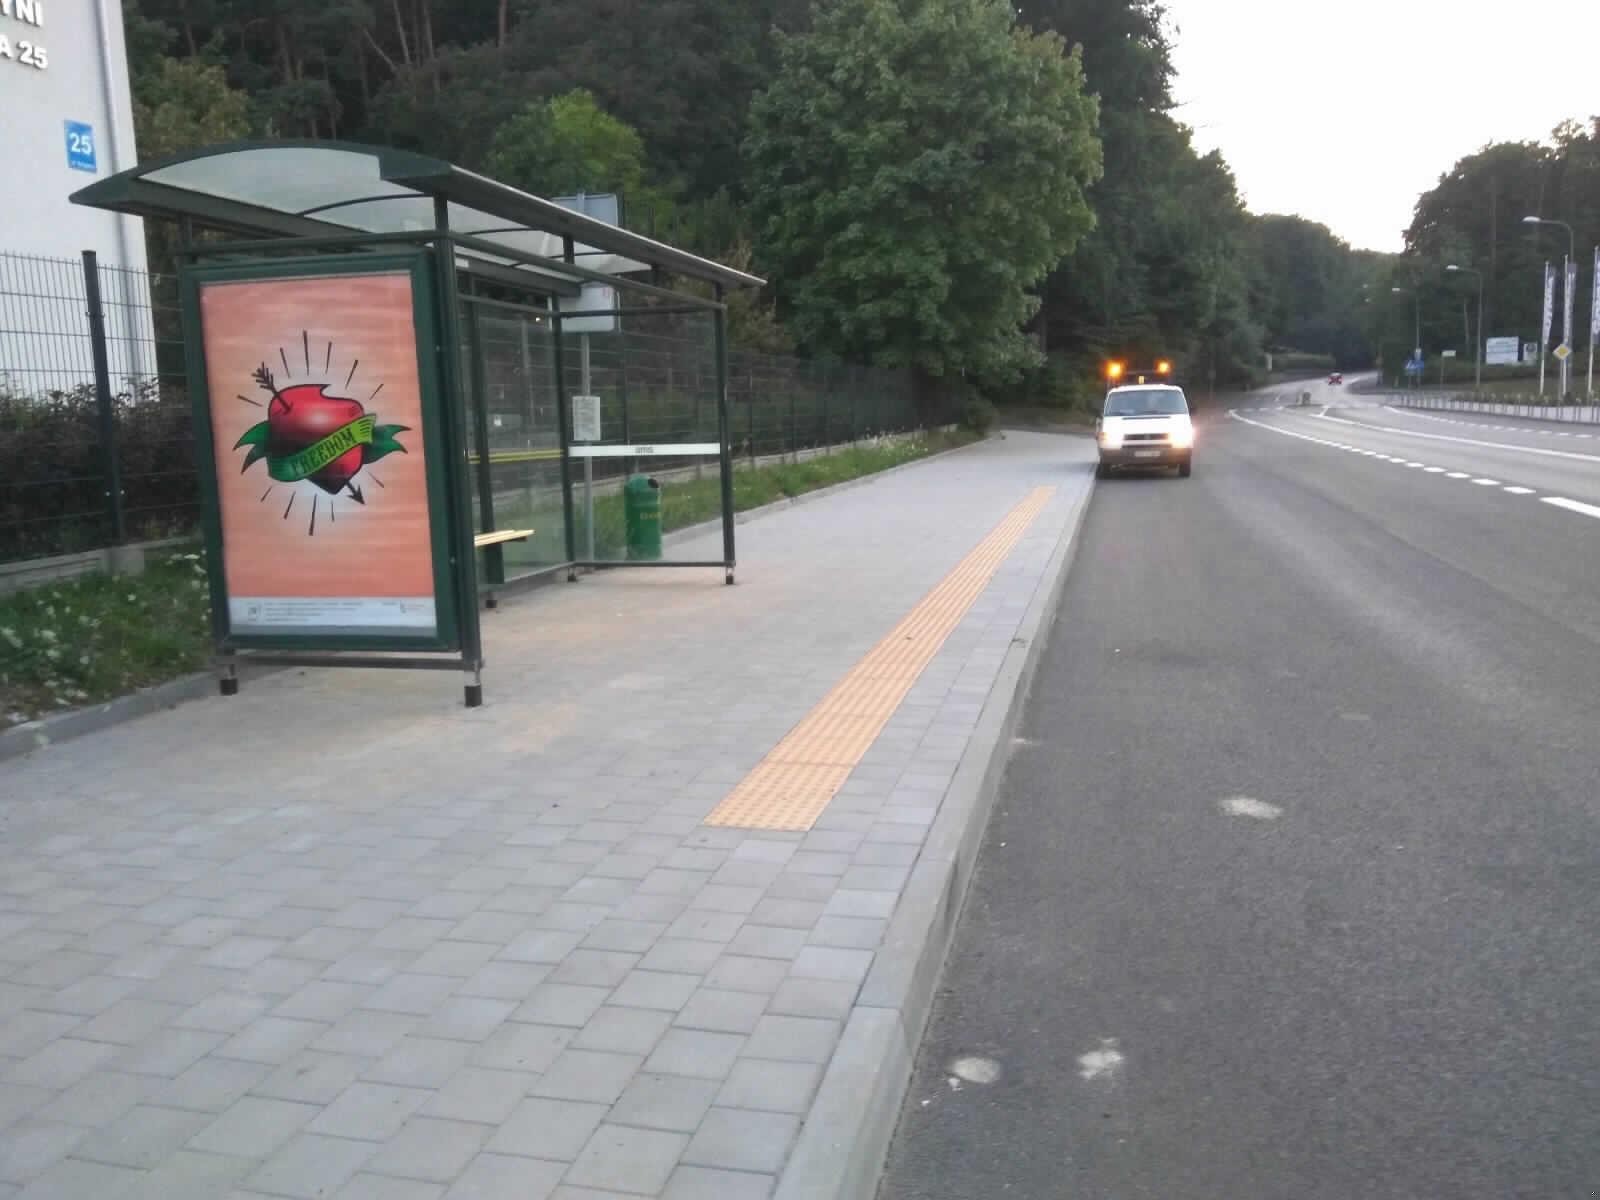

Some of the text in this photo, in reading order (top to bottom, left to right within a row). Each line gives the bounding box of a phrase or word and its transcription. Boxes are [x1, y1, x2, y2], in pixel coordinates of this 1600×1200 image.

[18, 41, 48, 69] 25
[69, 132, 92, 155] 25
[292, 426, 357, 474] FREEDOM
